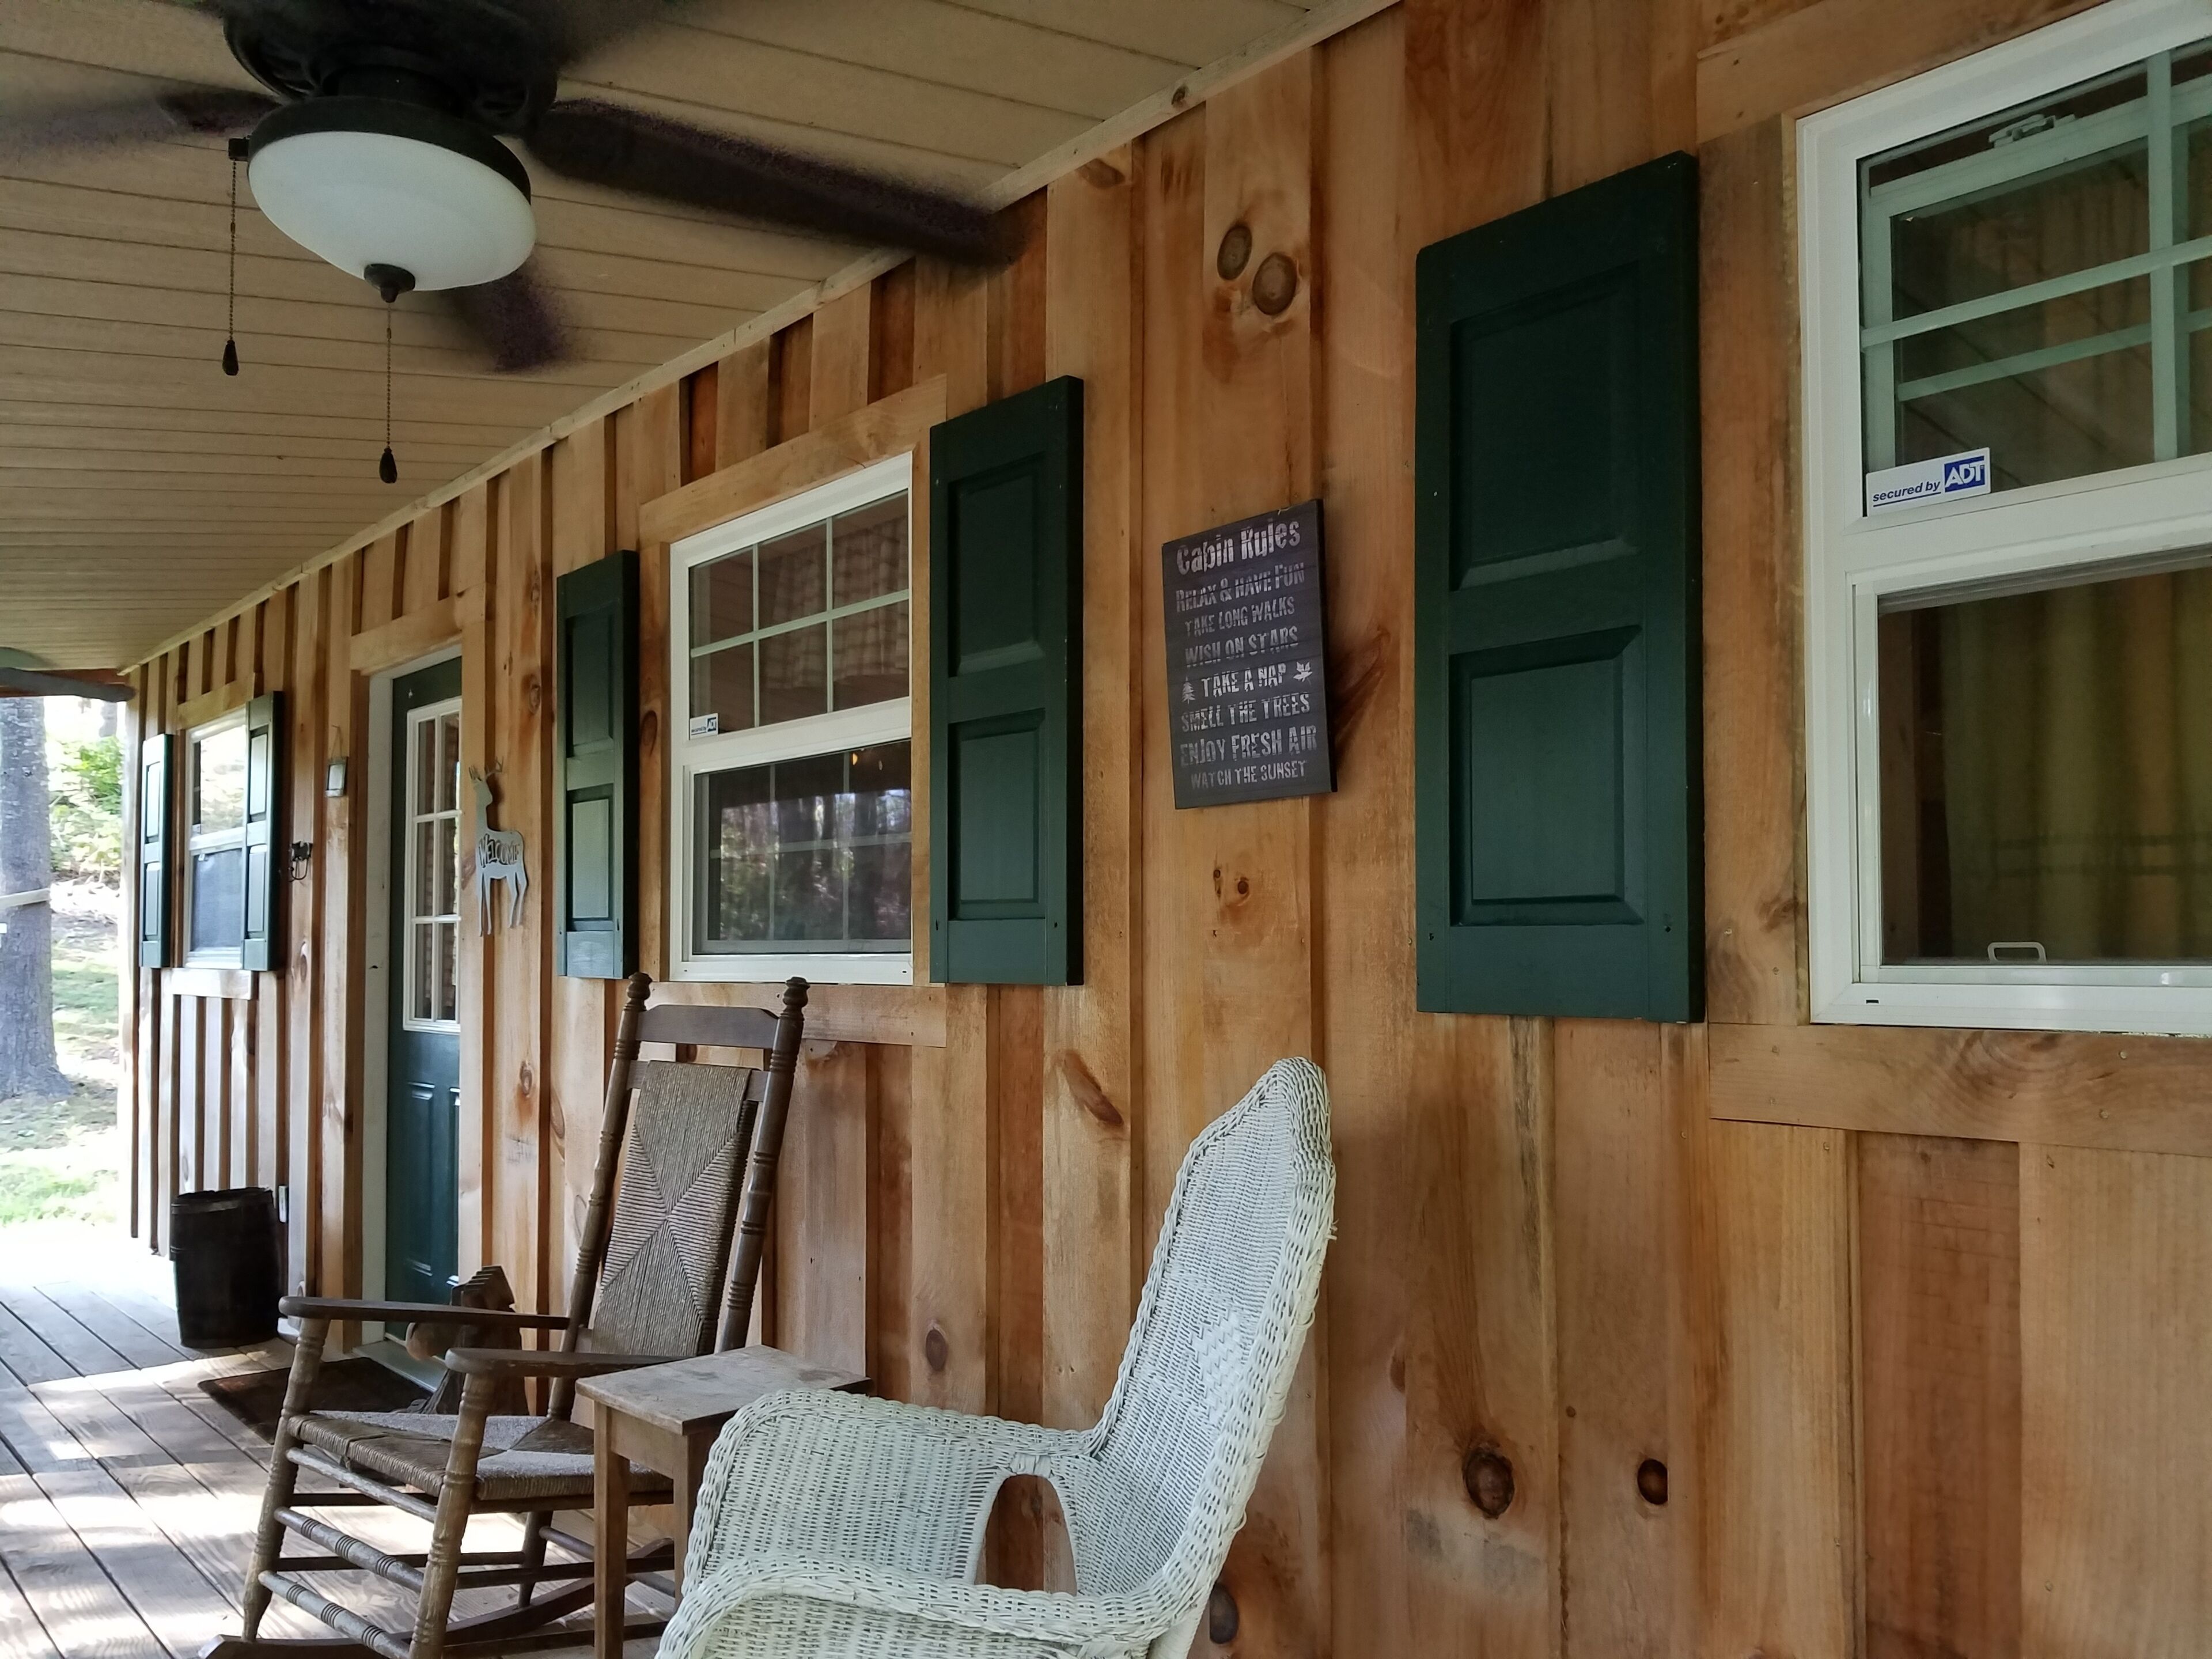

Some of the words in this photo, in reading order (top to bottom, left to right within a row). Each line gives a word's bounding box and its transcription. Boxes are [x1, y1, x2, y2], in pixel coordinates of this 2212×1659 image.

[1872, 482, 1923, 502] secured
[1925, 480, 1941, 492] by
[1945, 460, 1985, 488] ADT
[1177, 534, 1234, 575] Cabin
[1241, 520, 1300, 560] Rules
[1176, 584, 1217, 612] RELAX
[1219, 578, 1232, 602] &
[1234, 571, 1272, 597] HAVE
[1275, 562, 1305, 589] FUN
[1185, 614, 1215, 637] TAKE
[1218, 606, 1248, 630] LONG
[1251, 596, 1295, 623] WALKS
[1185, 641, 1221, 668] WISH
[1225, 636, 1244, 660] ON
[1248, 626, 1298, 655] STARS
[1201, 671, 1239, 698] TAKE
[1244, 668, 1254, 692] A
[1258, 662, 1286, 687] NAP
[1181, 704, 1224, 732] SMELL
[1228, 700, 1257, 725] THE
[1261, 692, 1310, 719] TREES
[1180, 738, 1225, 767] ENJOY
[1231, 729, 1282, 761] FRESH
[1289, 725, 1317, 755] AIR
[1191, 768, 1232, 789] WATCH
[1234, 766, 1257, 785] THE
[1260, 760, 1306, 781] SUNSET
[478, 833, 520, 868] WELCOME
